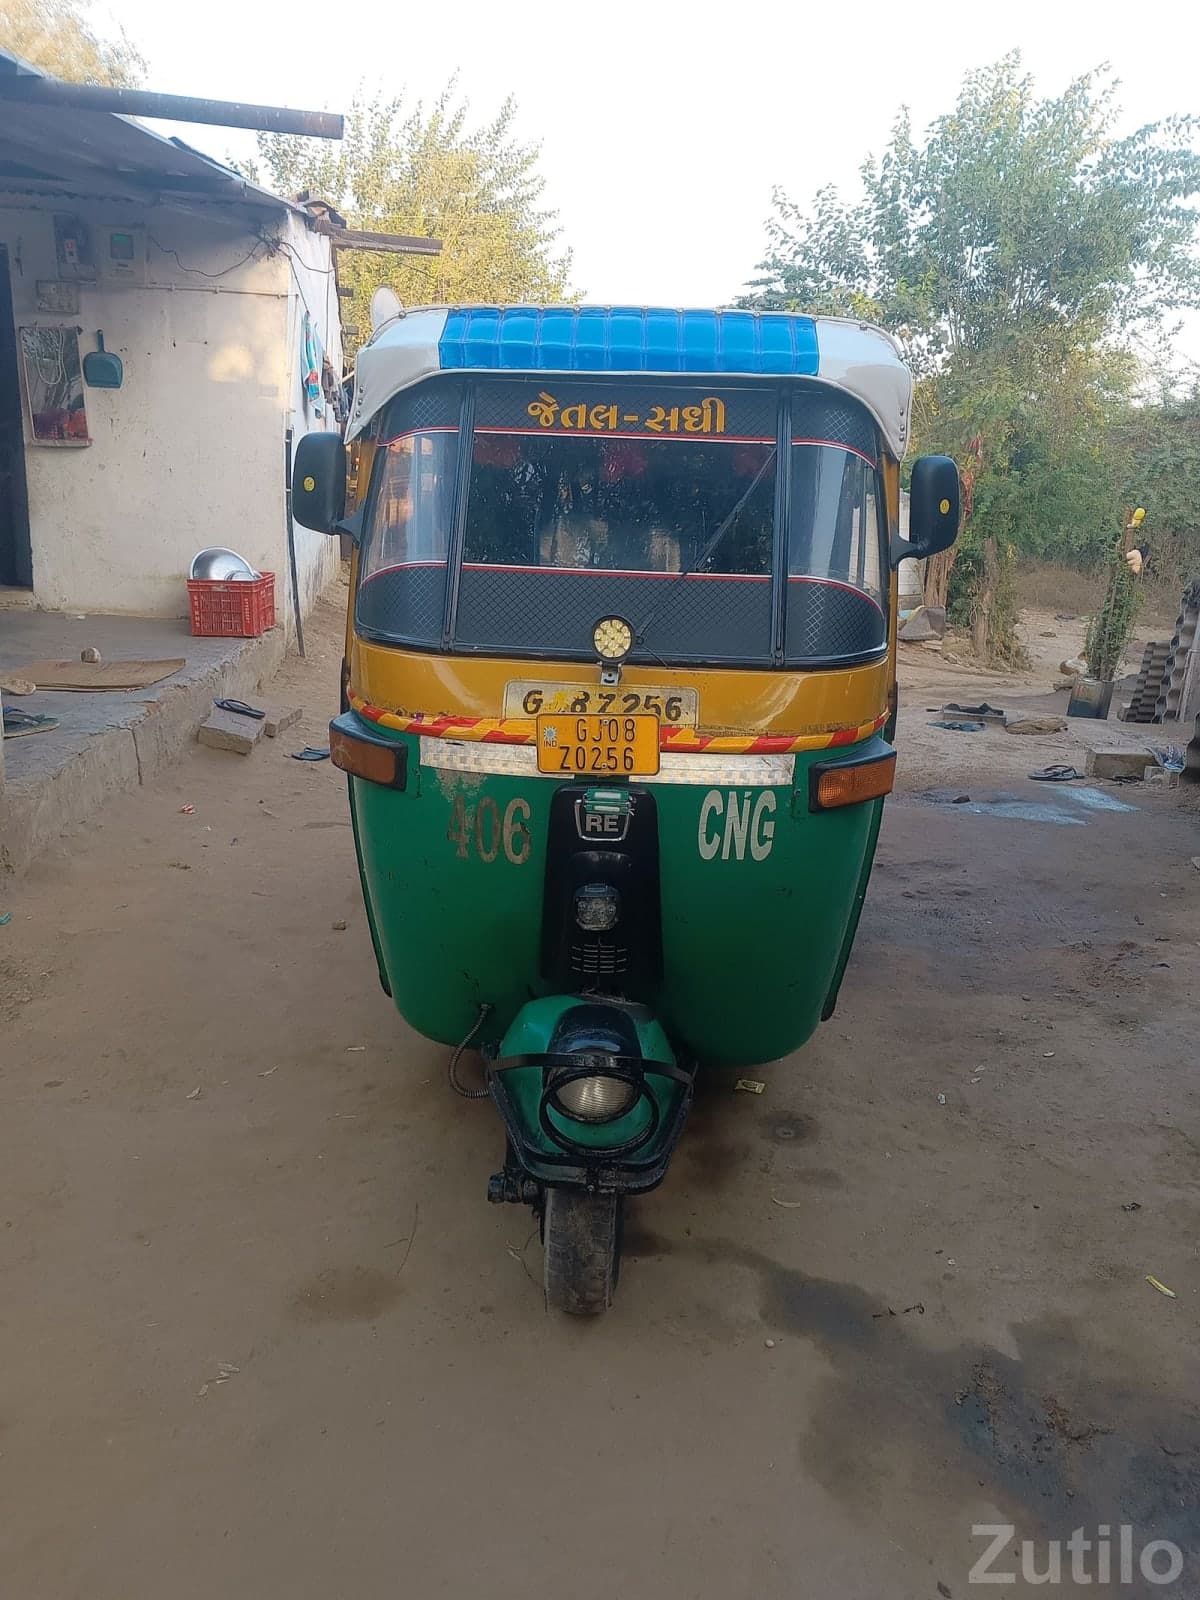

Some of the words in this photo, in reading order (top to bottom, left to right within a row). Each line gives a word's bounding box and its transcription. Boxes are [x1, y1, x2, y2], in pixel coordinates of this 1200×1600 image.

[576, 718, 636, 743] GJ08
[543, 740, 558, 748] IND
[559, 745, 634, 771] Z0256
[447, 794, 532, 865] 406
[585, 813, 619, 832] RE
[697, 789, 777, 862] CNG
